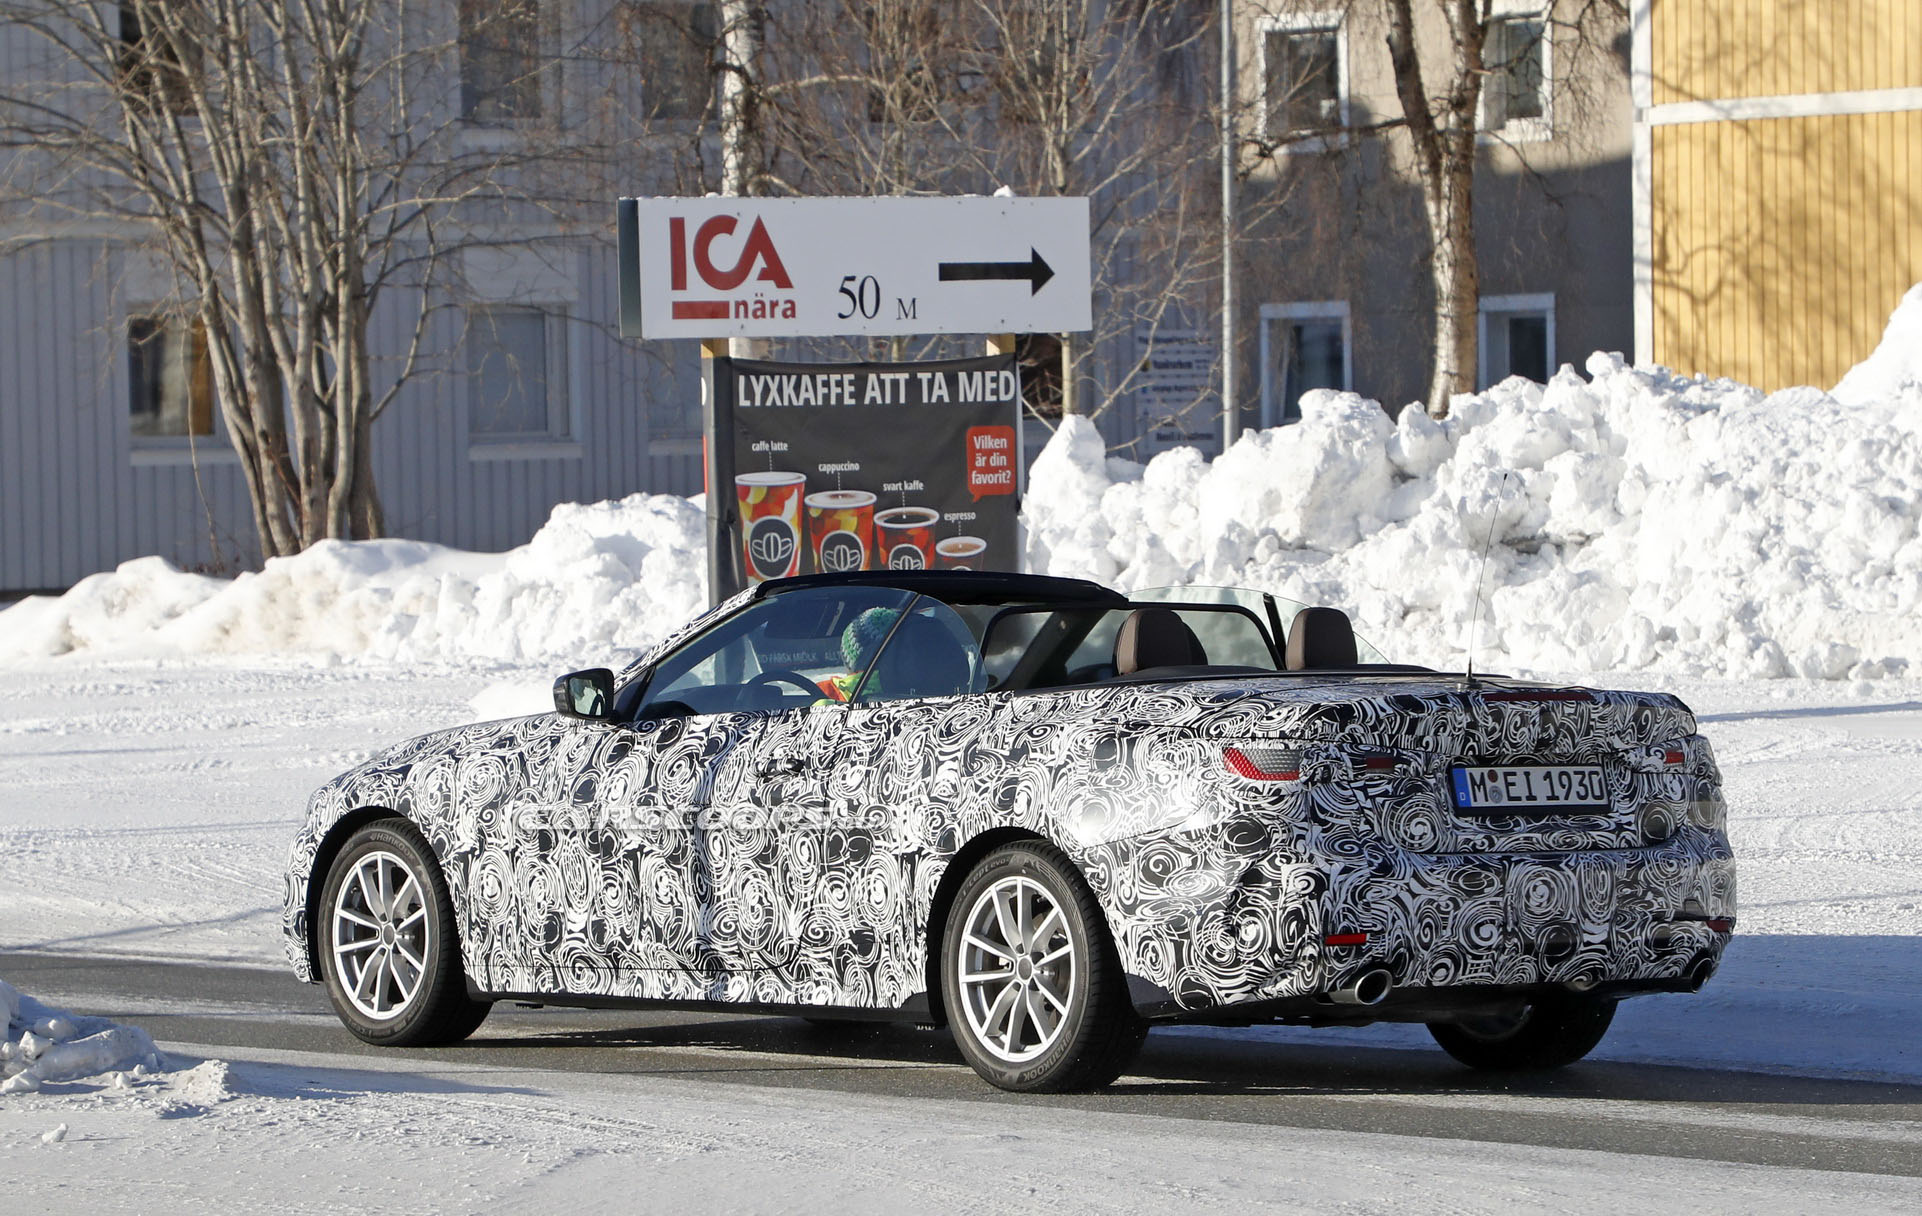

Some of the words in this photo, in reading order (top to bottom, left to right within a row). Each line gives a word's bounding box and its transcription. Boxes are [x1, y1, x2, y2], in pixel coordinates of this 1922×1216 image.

[669, 214, 794, 291] ICA
[837, 275, 881, 320] 50
[896, 298, 918, 320] M
[734, 293, 796, 320] nära
[738, 373, 856, 407] LYXKAFFE
[864, 373, 910, 405] ATT
[917, 372, 950, 404] TA
[958, 370, 1017, 402] MED
[770, 440, 789, 452] latte
[973, 435, 1008, 449] Vilken
[975, 452, 987, 467] är
[989, 452, 1007, 467] din
[818, 460, 860, 475] cappuccino
[971, 470, 1012, 485] favorit?
[883, 482, 903, 492] svart
[903, 480, 924, 491] kaffe
[943, 511, 977, 524] espresso
[1459, 791, 1466, 801] D
[1469, 771, 1489, 803] M
[1502, 771, 1538, 802] EI
[1542, 770, 1606, 802] 1930
